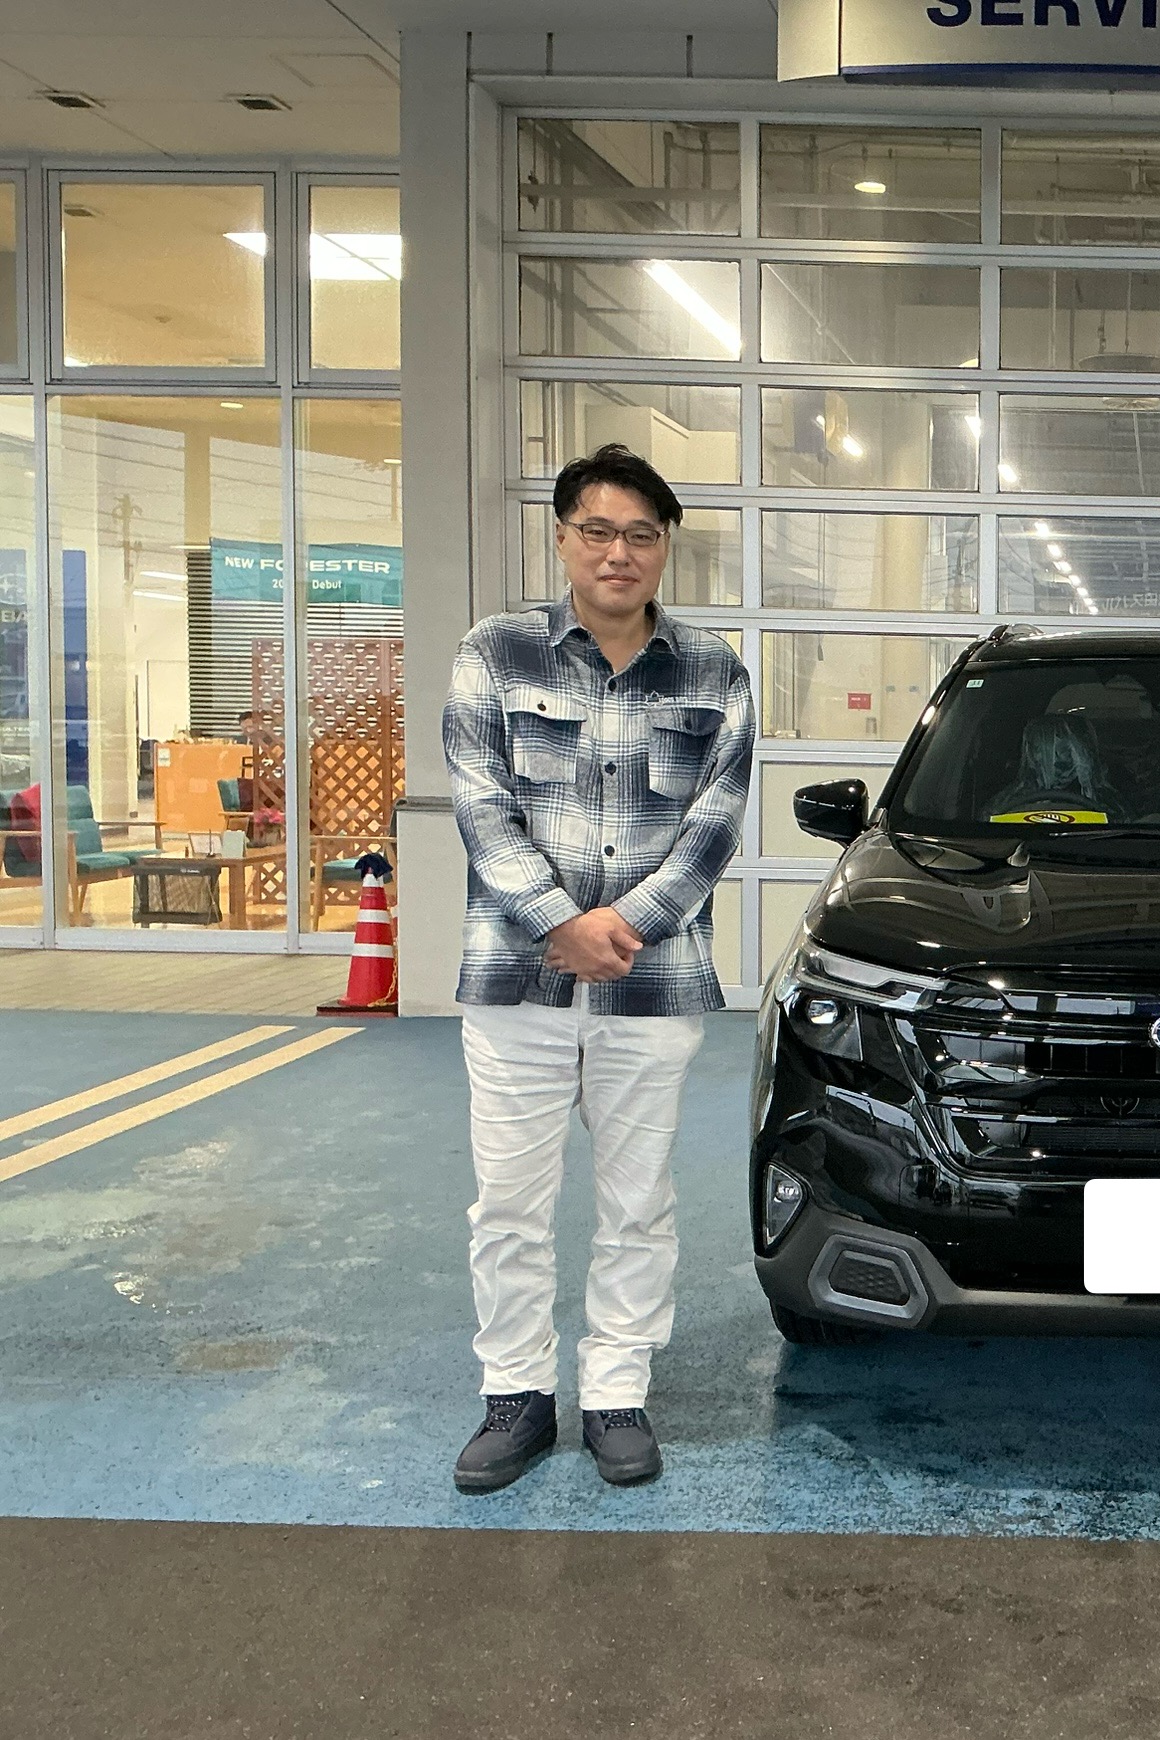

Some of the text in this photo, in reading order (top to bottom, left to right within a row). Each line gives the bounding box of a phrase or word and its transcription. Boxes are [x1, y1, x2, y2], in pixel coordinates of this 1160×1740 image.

[225, 556, 390, 573] NEW FOESTER
[312, 580, 342, 589] Debut
